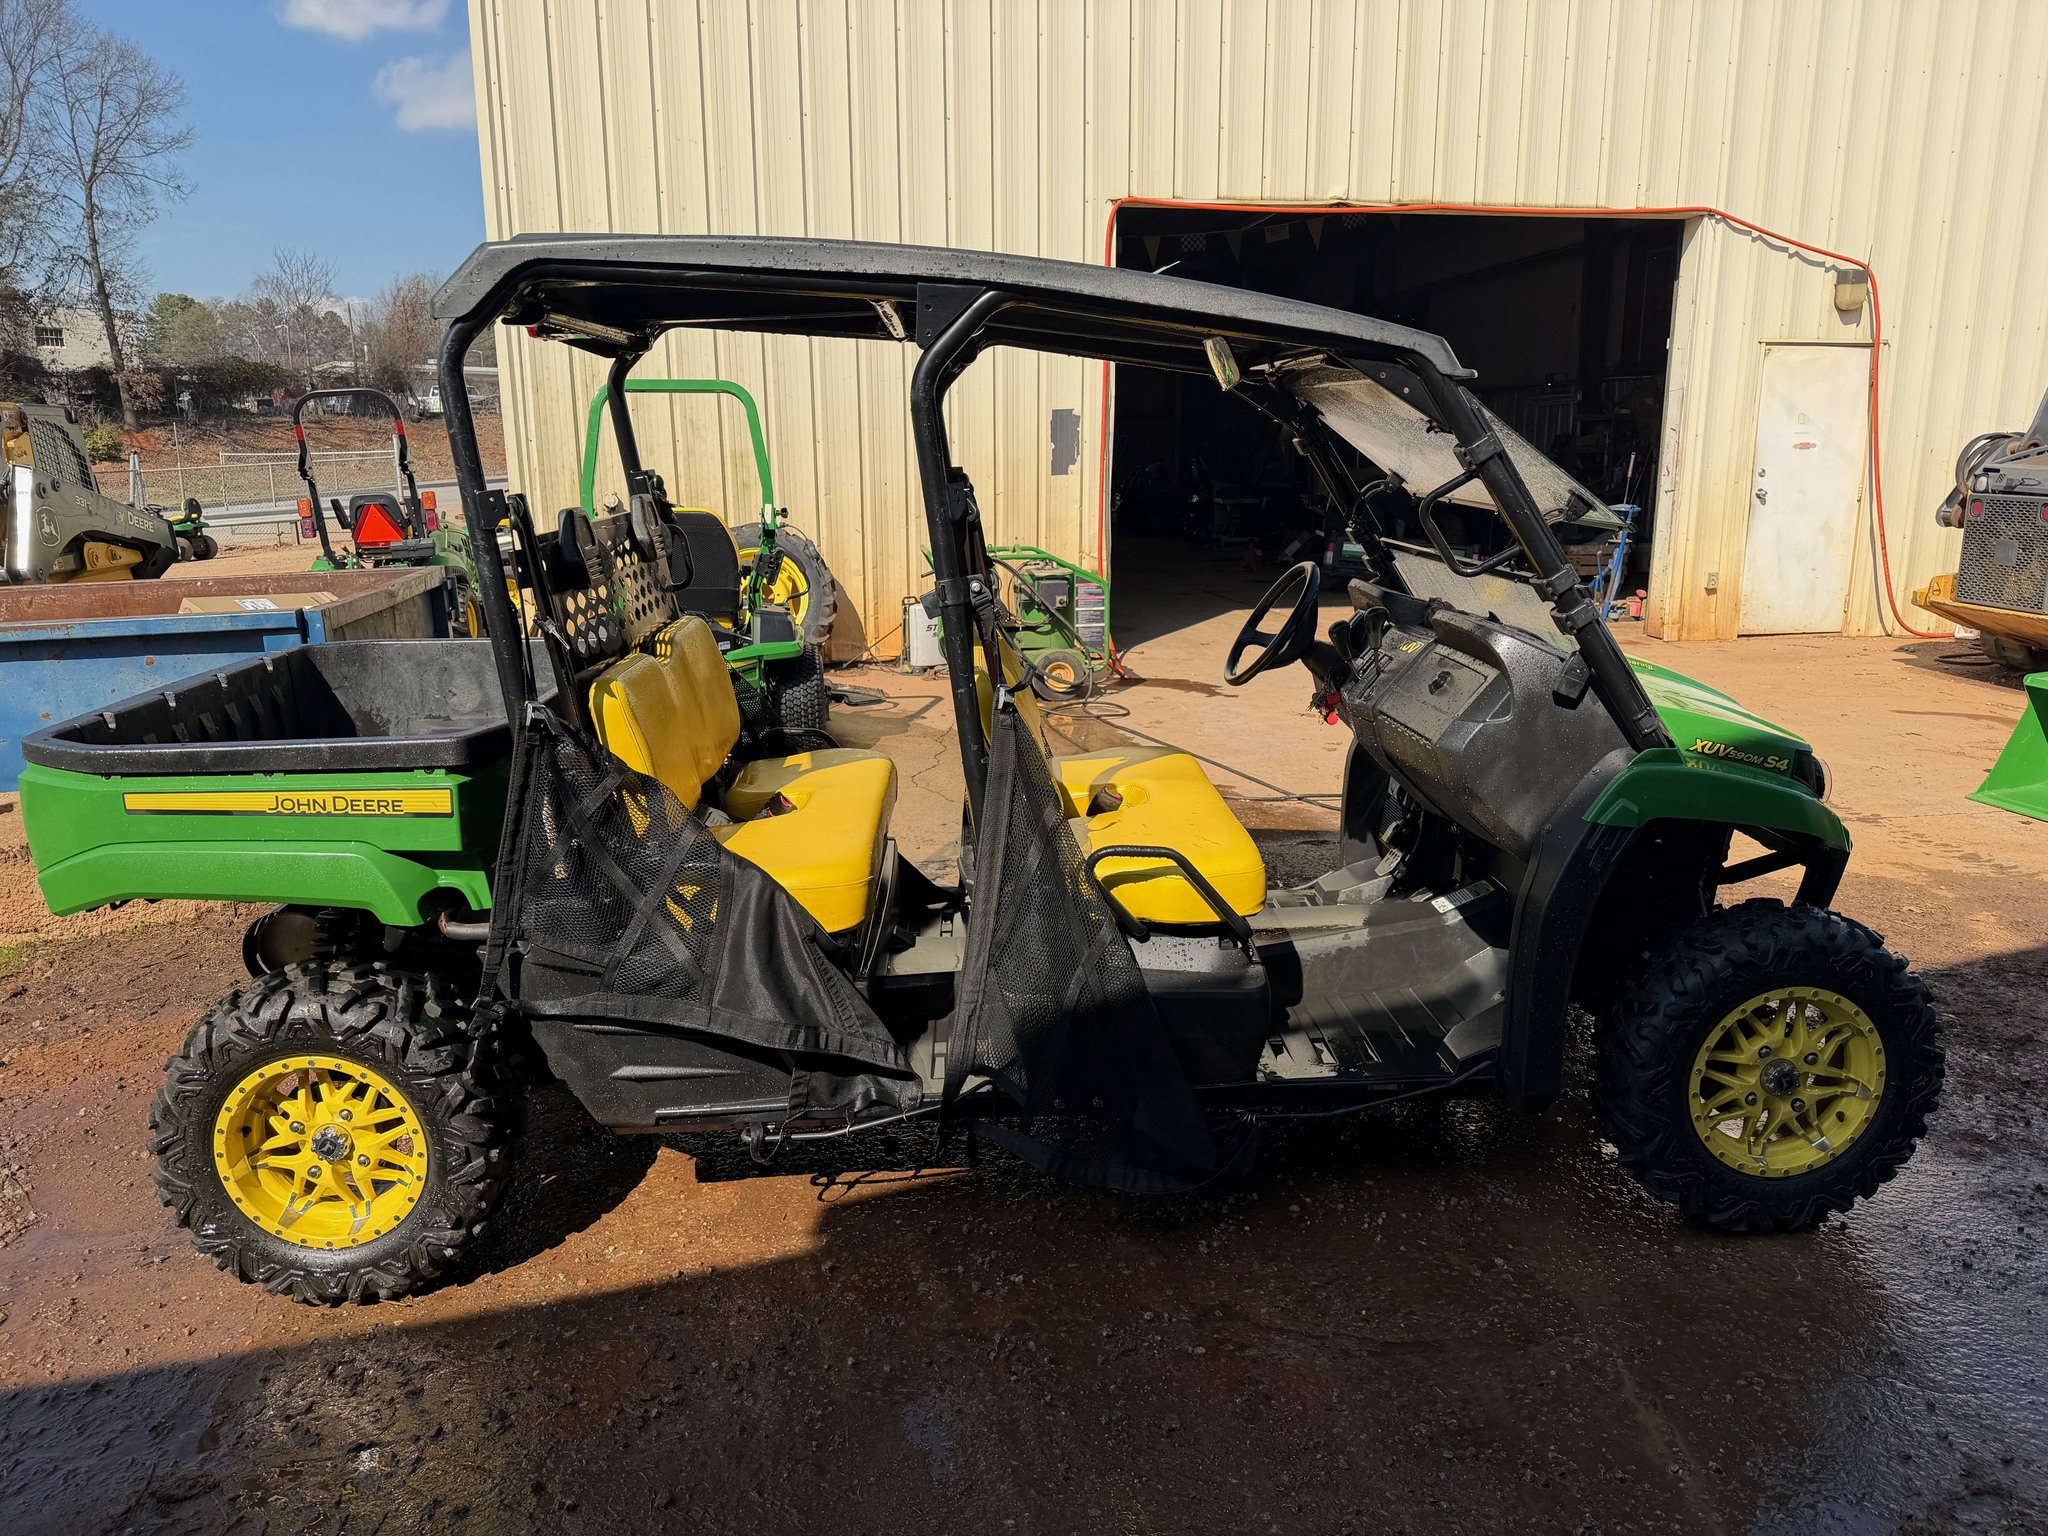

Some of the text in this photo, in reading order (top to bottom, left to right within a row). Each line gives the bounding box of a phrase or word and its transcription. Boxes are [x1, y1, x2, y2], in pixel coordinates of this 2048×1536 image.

[127, 511, 155, 533] DEERE
[1763, 755, 1790, 771] S4
[267, 795, 405, 812] JOHN DEERE
